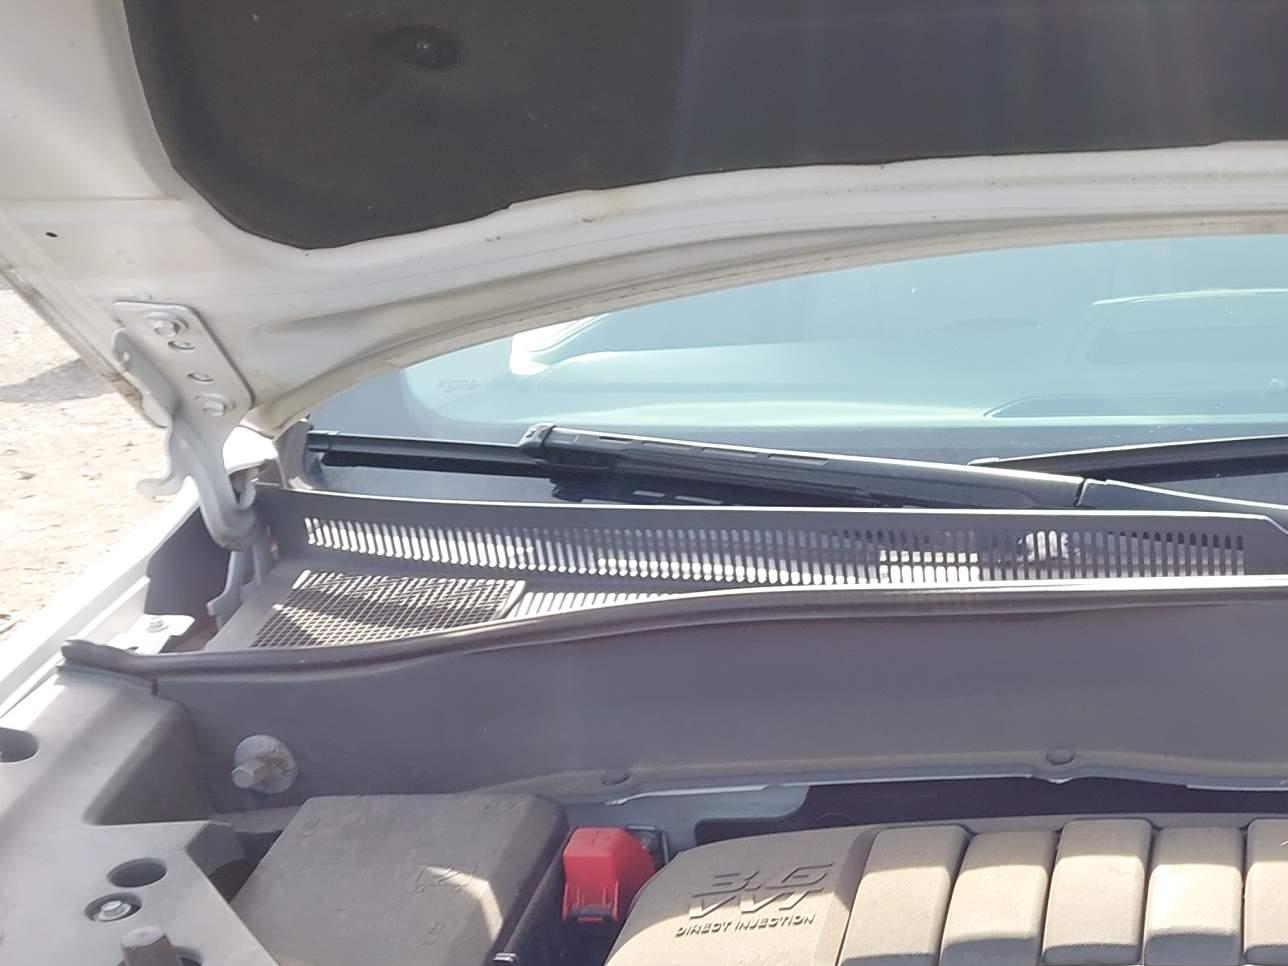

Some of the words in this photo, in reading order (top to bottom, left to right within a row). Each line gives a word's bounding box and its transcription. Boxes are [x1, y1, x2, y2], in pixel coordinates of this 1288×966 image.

[691, 862, 834, 898] 3.6
[688, 887, 825, 920] VVT
[674, 920, 732, 938] DIRECT
[734, 913, 816, 933] INJECTION
